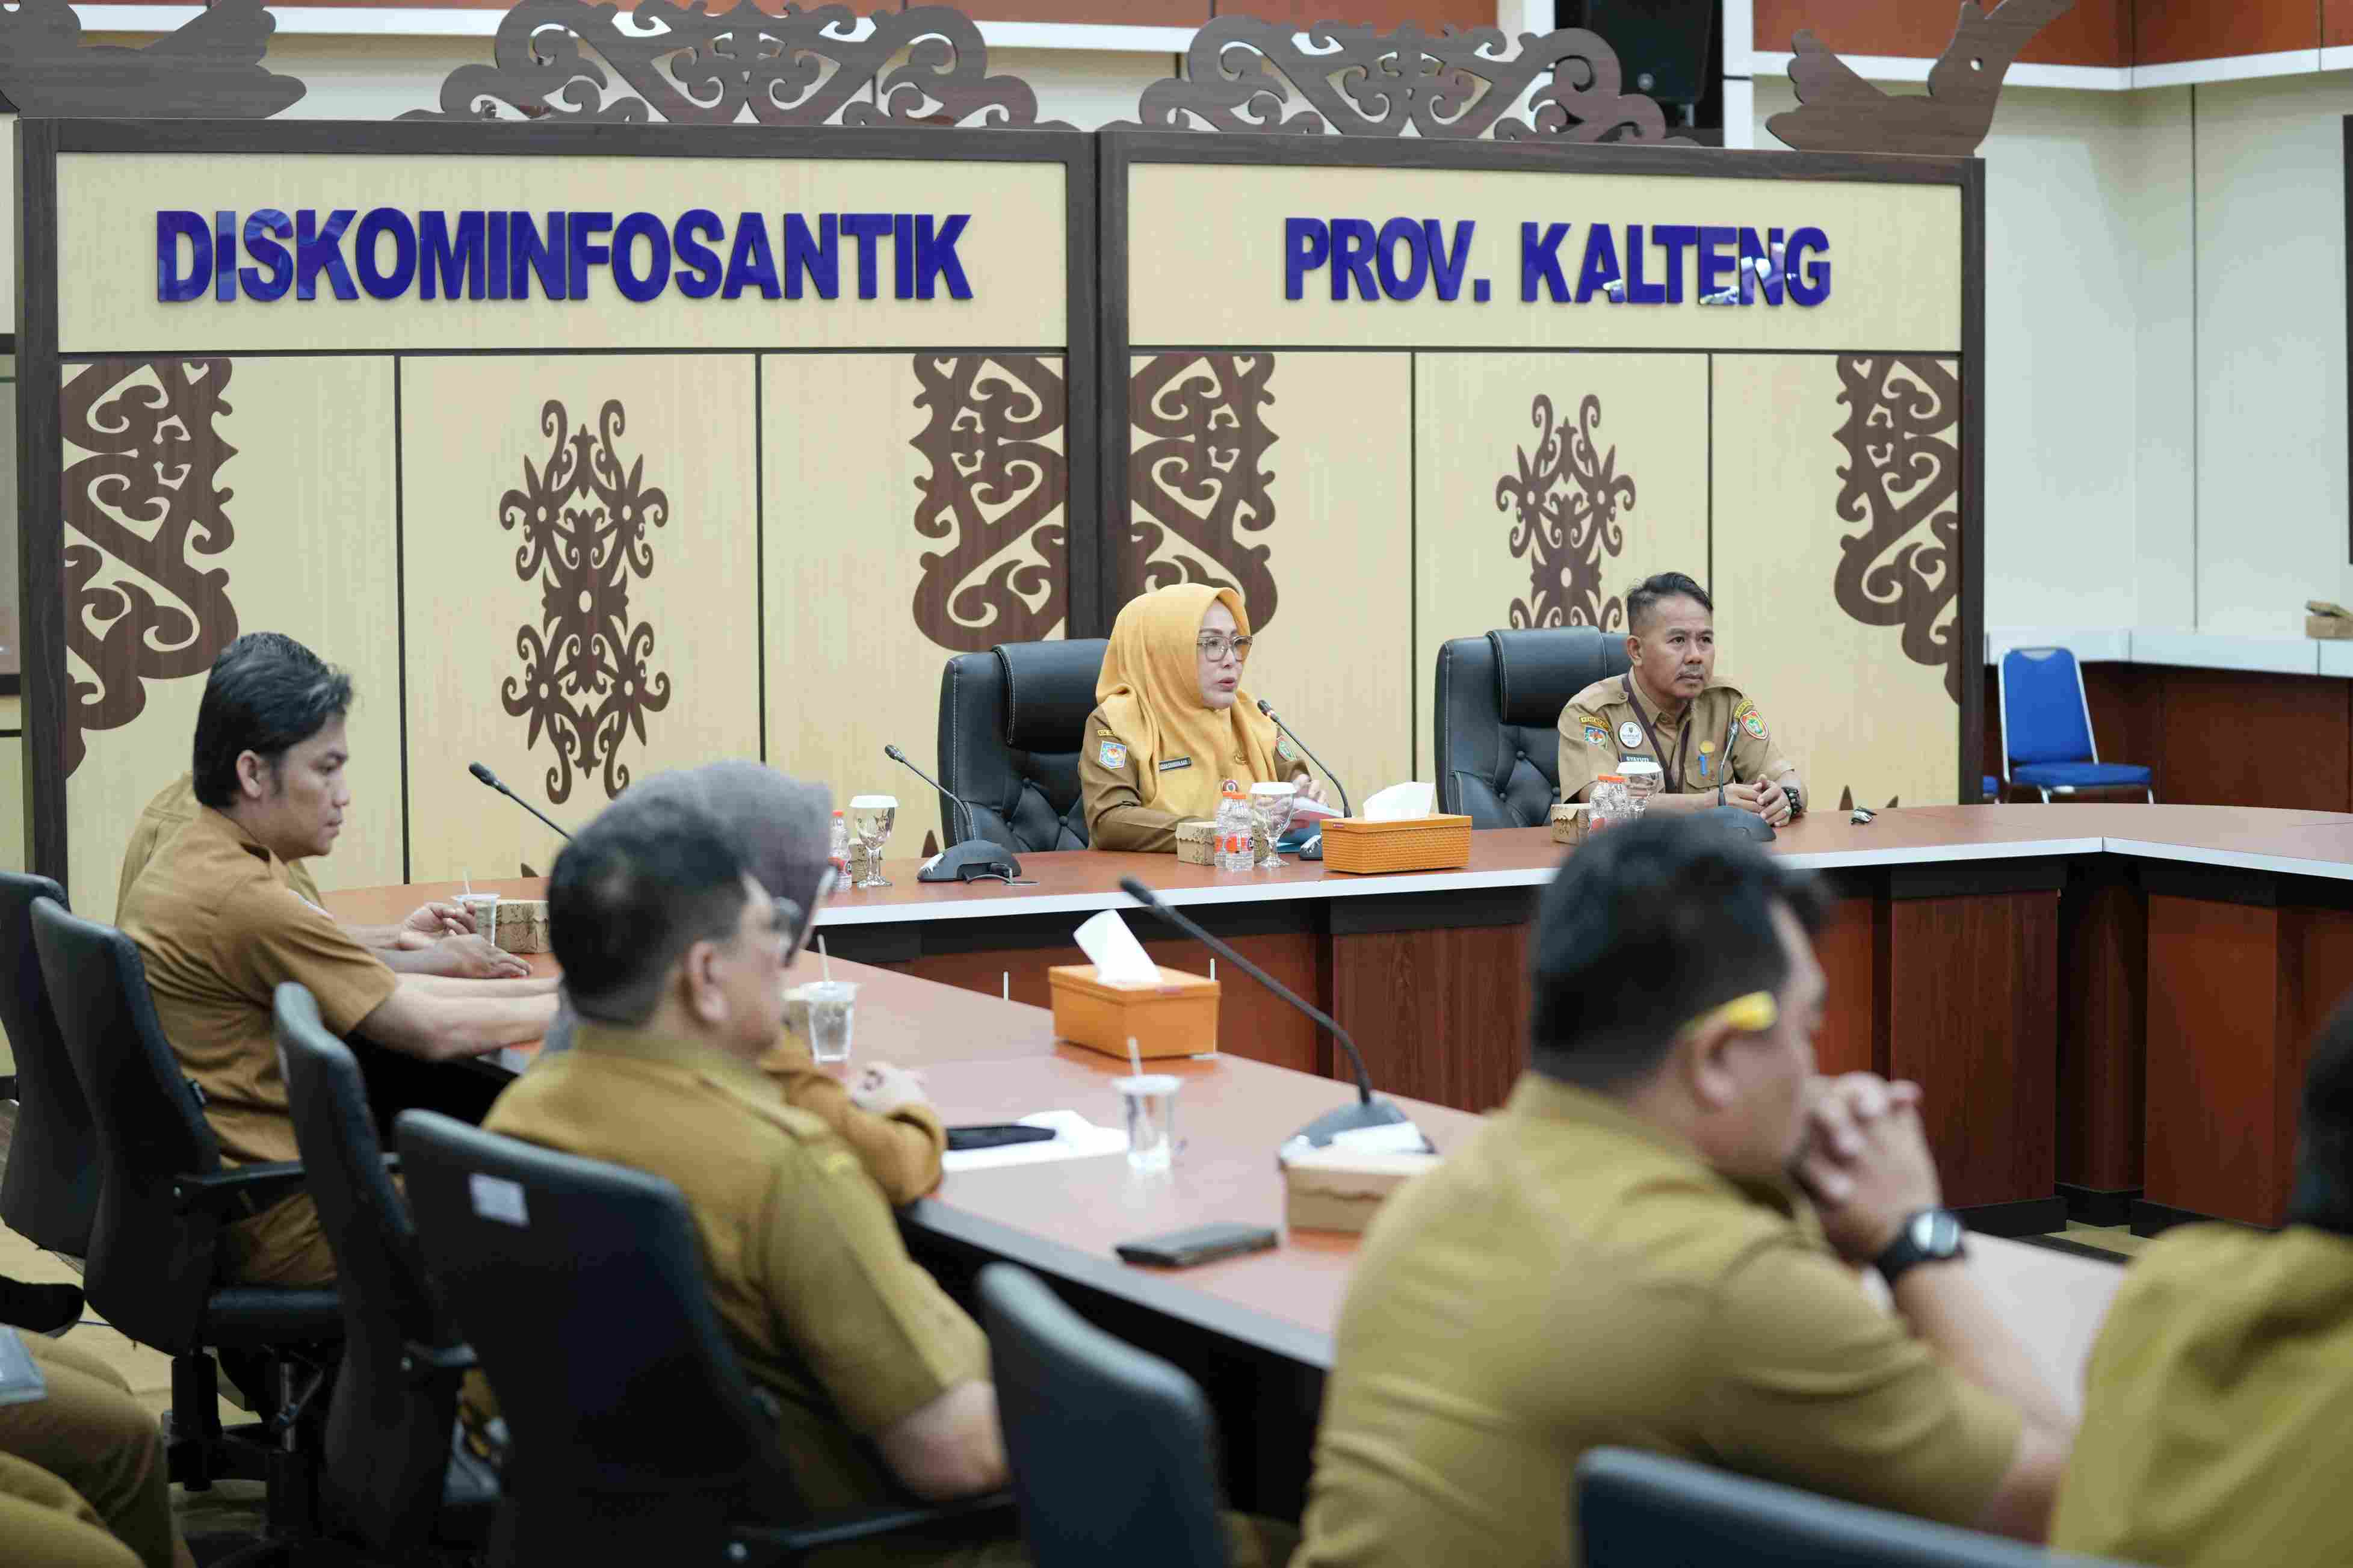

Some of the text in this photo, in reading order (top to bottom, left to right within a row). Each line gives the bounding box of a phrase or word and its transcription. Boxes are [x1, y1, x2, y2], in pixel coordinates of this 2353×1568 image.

[156, 207, 974, 302] DISKOMINFOSANTIK
[1285, 217, 1831, 306] PROV. KALTENG
